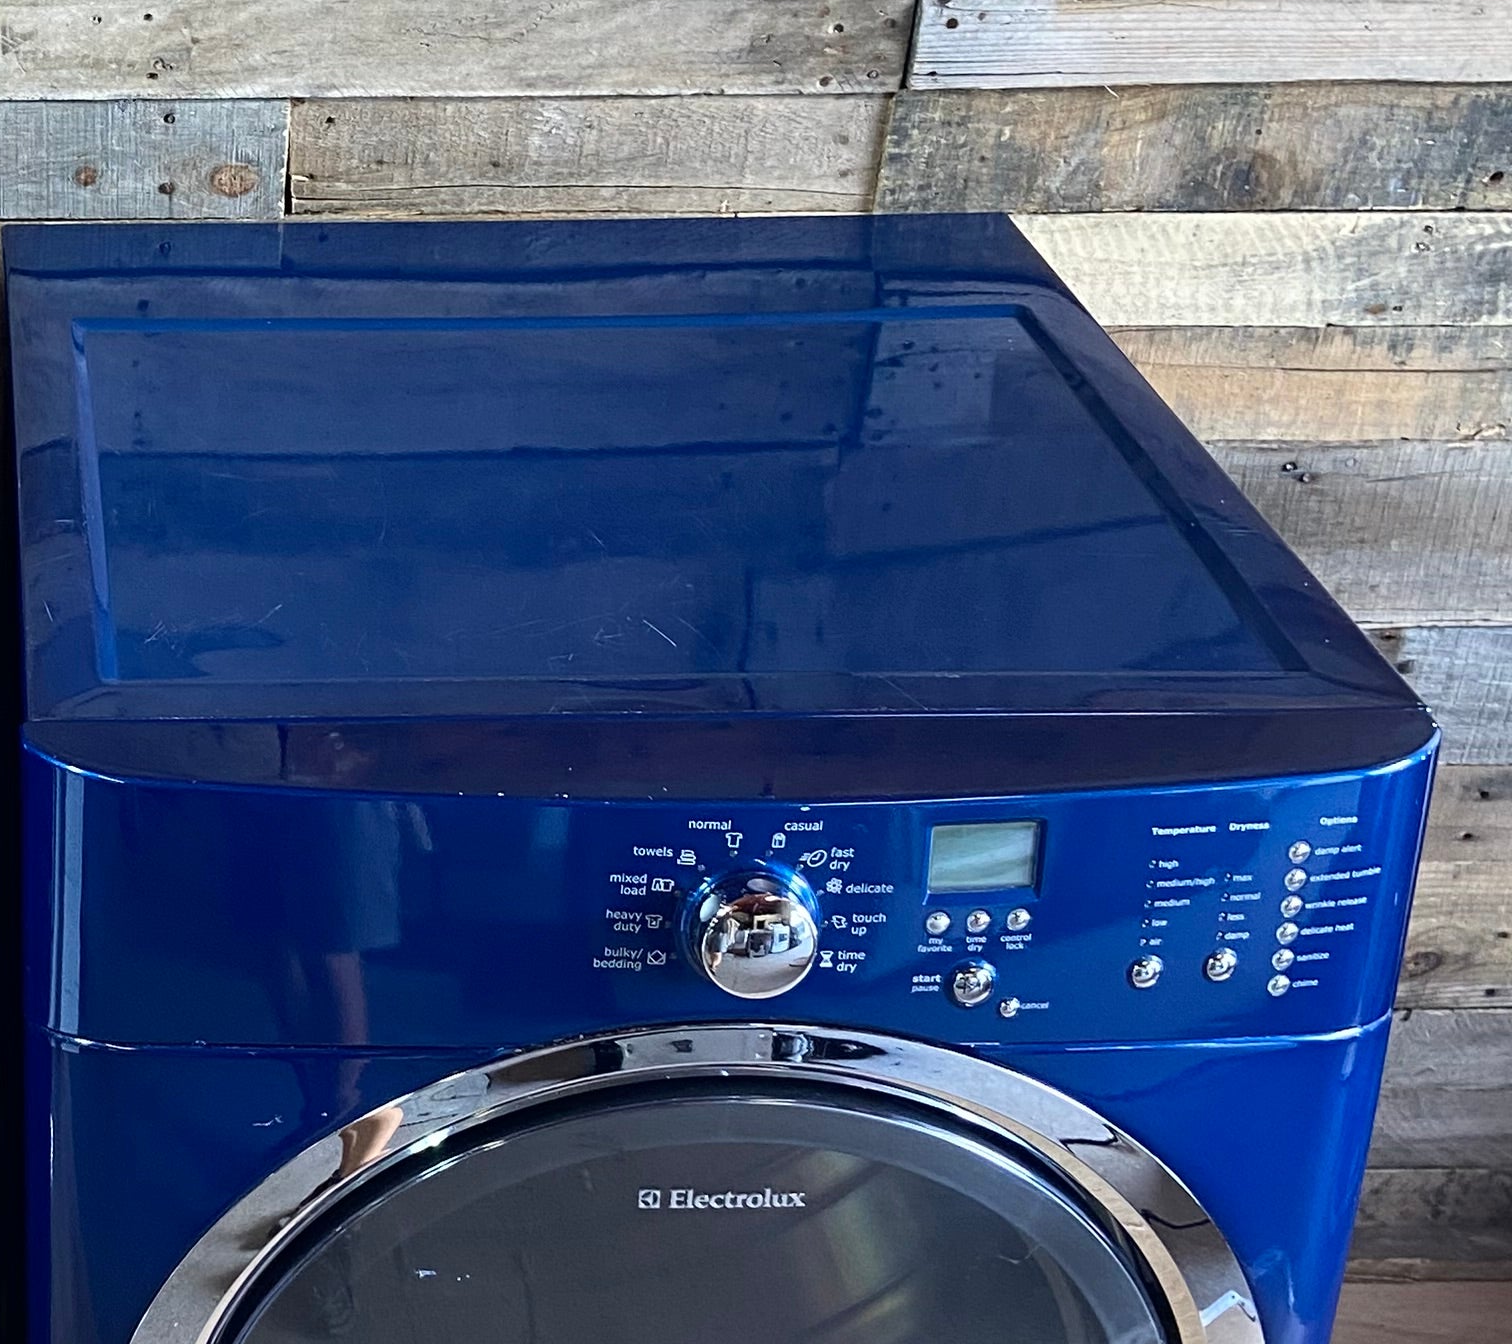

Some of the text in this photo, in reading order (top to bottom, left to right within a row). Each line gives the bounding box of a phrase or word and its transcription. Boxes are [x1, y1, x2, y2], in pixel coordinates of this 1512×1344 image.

[688, 820, 732, 830] normal
[784, 820, 823, 831] casual
[1320, 816, 1358, 826] Options
[1152, 825, 1216, 836] Temperature
[1229, 822, 1270, 832] Dryness
[633, 846, 674, 857] towels
[830, 847, 855, 857] fast
[829, 860, 850, 871] dry
[1158, 860, 1179, 869] high
[609, 873, 648, 884] mixed
[1156, 877, 1215, 887] medium/high
[620, 884, 647, 895] load
[845, 883, 894, 894] delicate
[1229, 892, 1261, 901] normal
[1154, 899, 1190, 907] medium
[606, 909, 642, 920] heavy
[852, 913, 886, 923] touch
[613, 921, 642, 933] duty
[1151, 919, 1167, 927] low
[851, 925, 867, 936] up
[928, 937, 943, 945] my
[1000, 933, 1032, 942] control
[917, 944, 953, 953] favorite
[967, 943, 983, 952] dry
[1006, 942, 1024, 950] lock
[604, 947, 644, 959] bulky/
[838, 950, 866, 960] time
[593, 958, 642, 971] bedding
[836, 962, 857, 973] dry
[912, 975, 942, 983] start
[911, 984, 940, 993] pause
[669, 1187, 806, 1209] Electrolux
